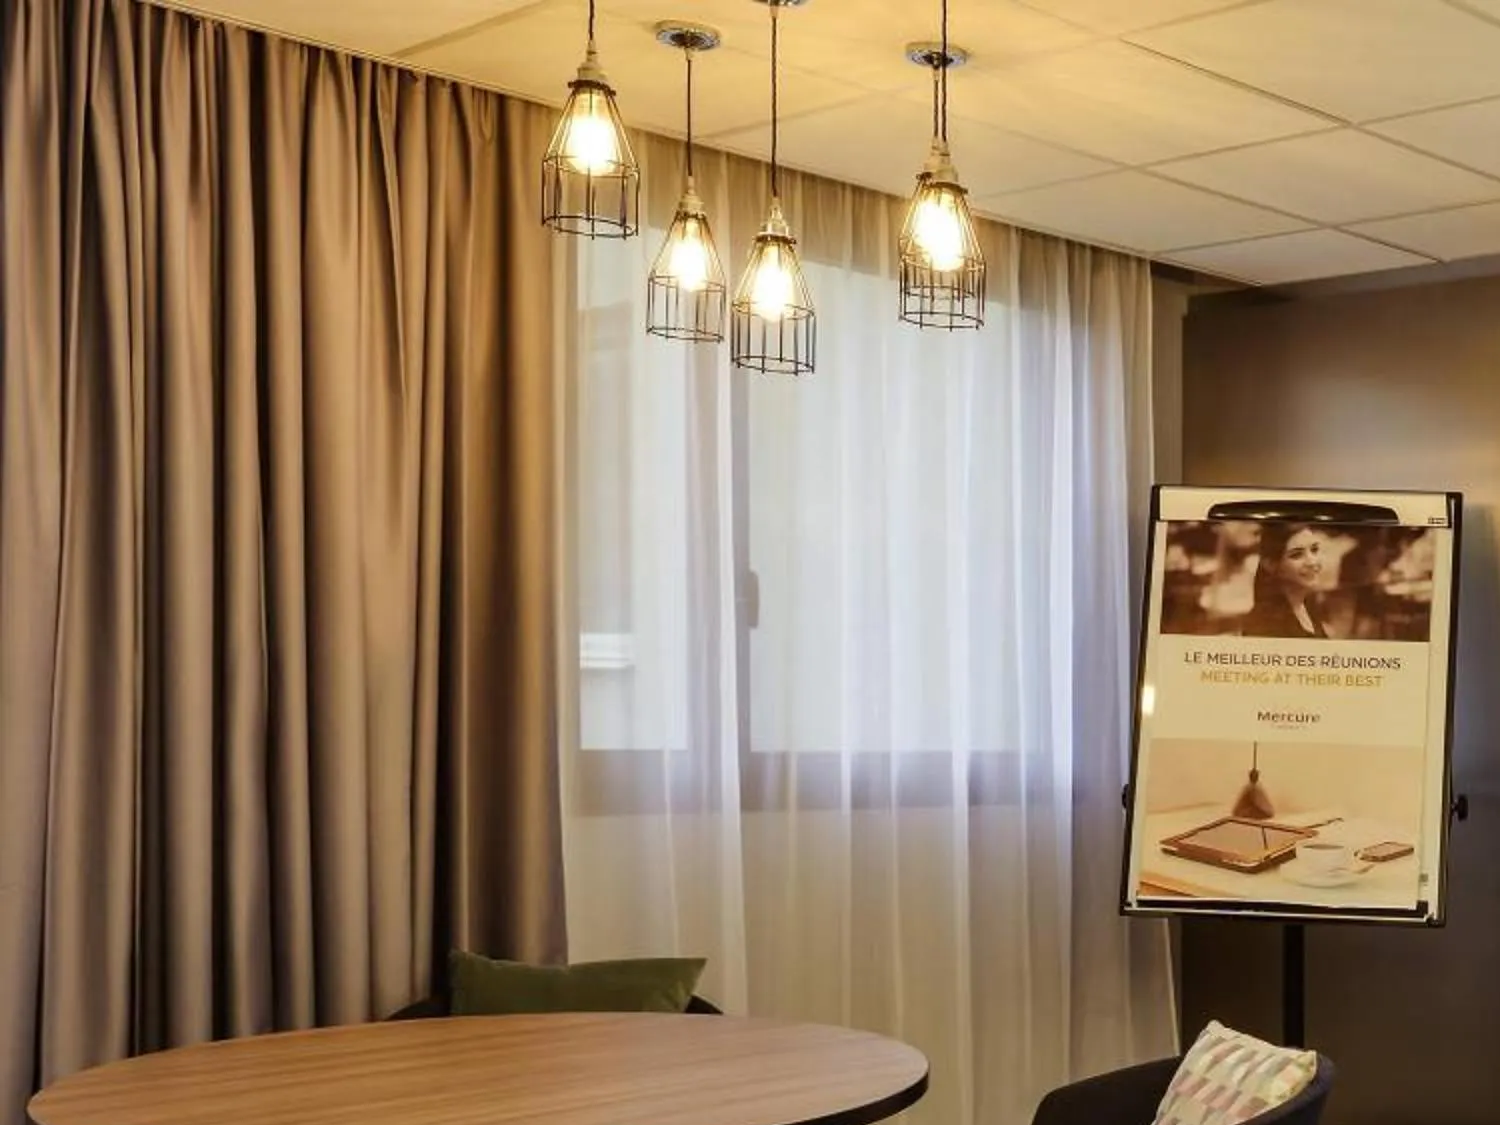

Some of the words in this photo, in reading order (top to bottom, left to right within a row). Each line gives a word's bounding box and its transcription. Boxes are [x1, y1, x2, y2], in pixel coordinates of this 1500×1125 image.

[1184, 651, 1202, 664] LE
[1206, 652, 1282, 667] MEILLEUR
[1285, 655, 1316, 668] DES
[1321, 653, 1401, 670] RÉUNIONS
[1200, 670, 1269, 684] MEETING
[1273, 671, 1291, 684] AT
[1297, 673, 1341, 687] THEIR
[1345, 674, 1384, 688] BEST
[1256, 710, 1322, 724] Mercure
